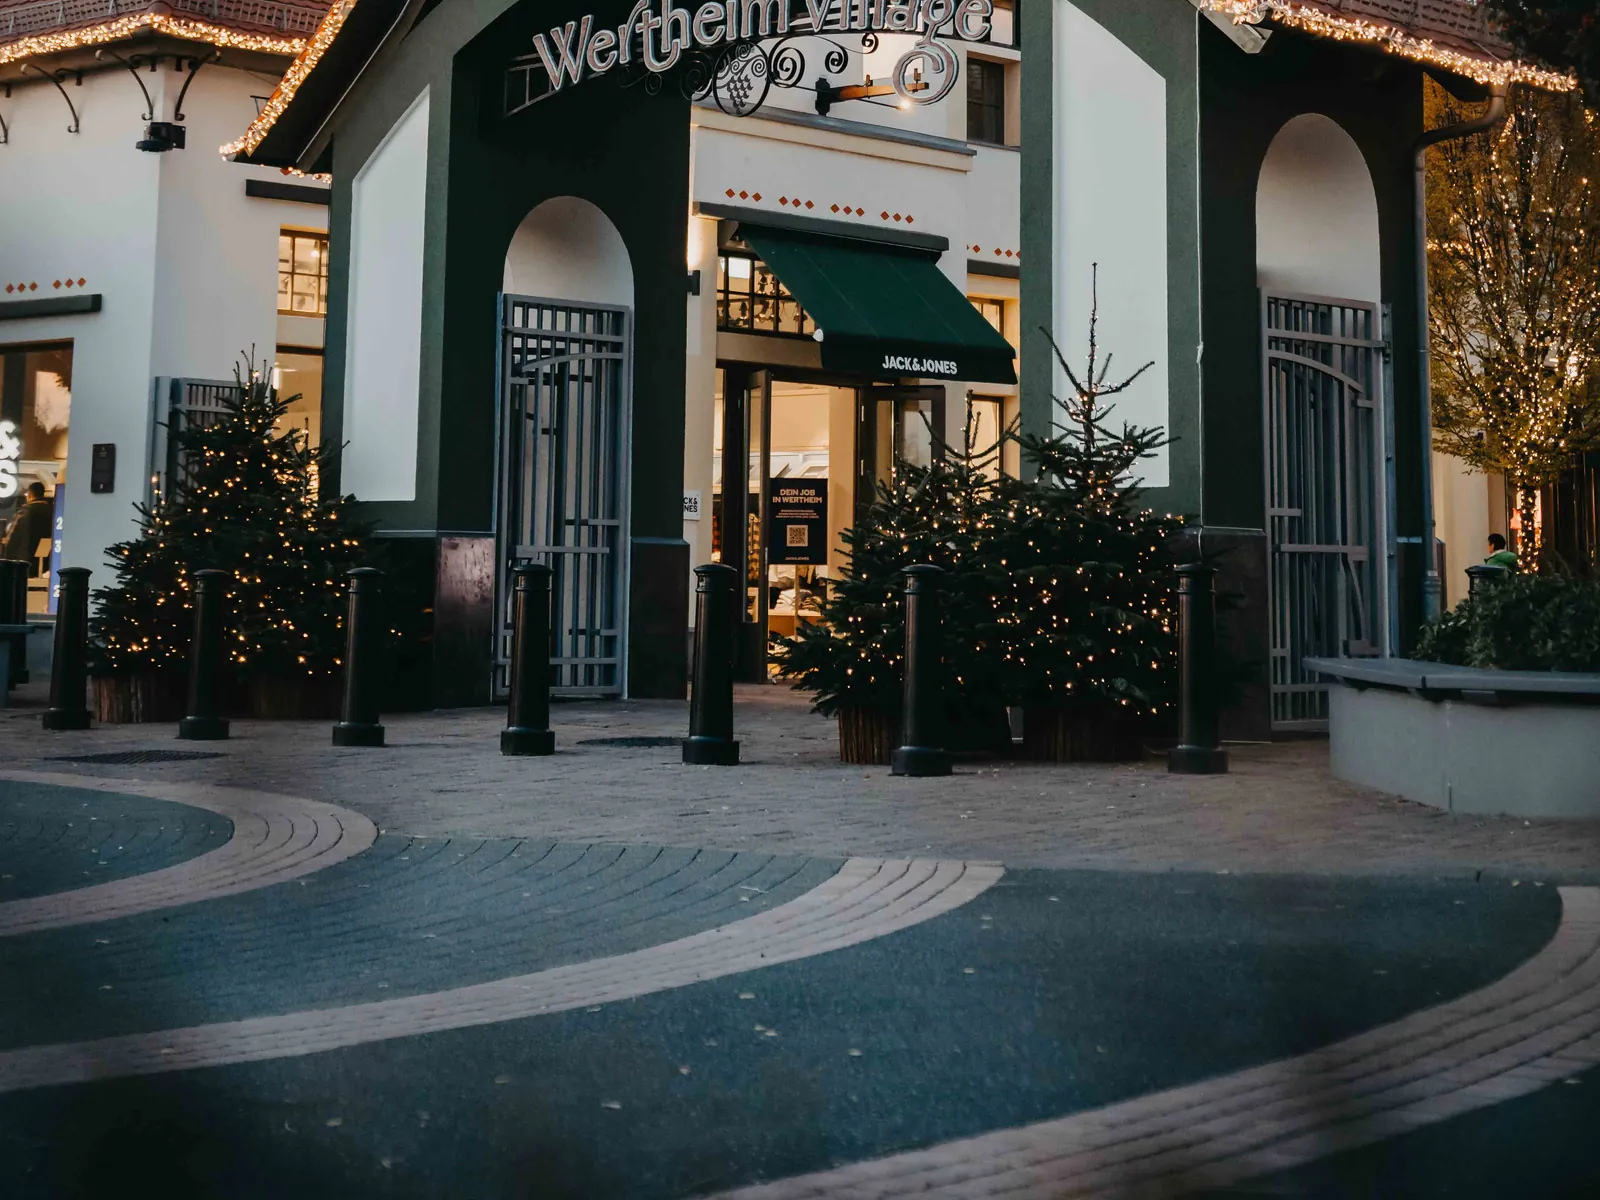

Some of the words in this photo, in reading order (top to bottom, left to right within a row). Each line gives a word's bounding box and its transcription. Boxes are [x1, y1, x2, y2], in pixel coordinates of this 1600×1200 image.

[882, 355, 958, 374] JACK&JONES
[683, 496, 698, 505] CK&
[782, 496, 823, 504] WERTHEIM
[683, 504, 698, 513] NES
